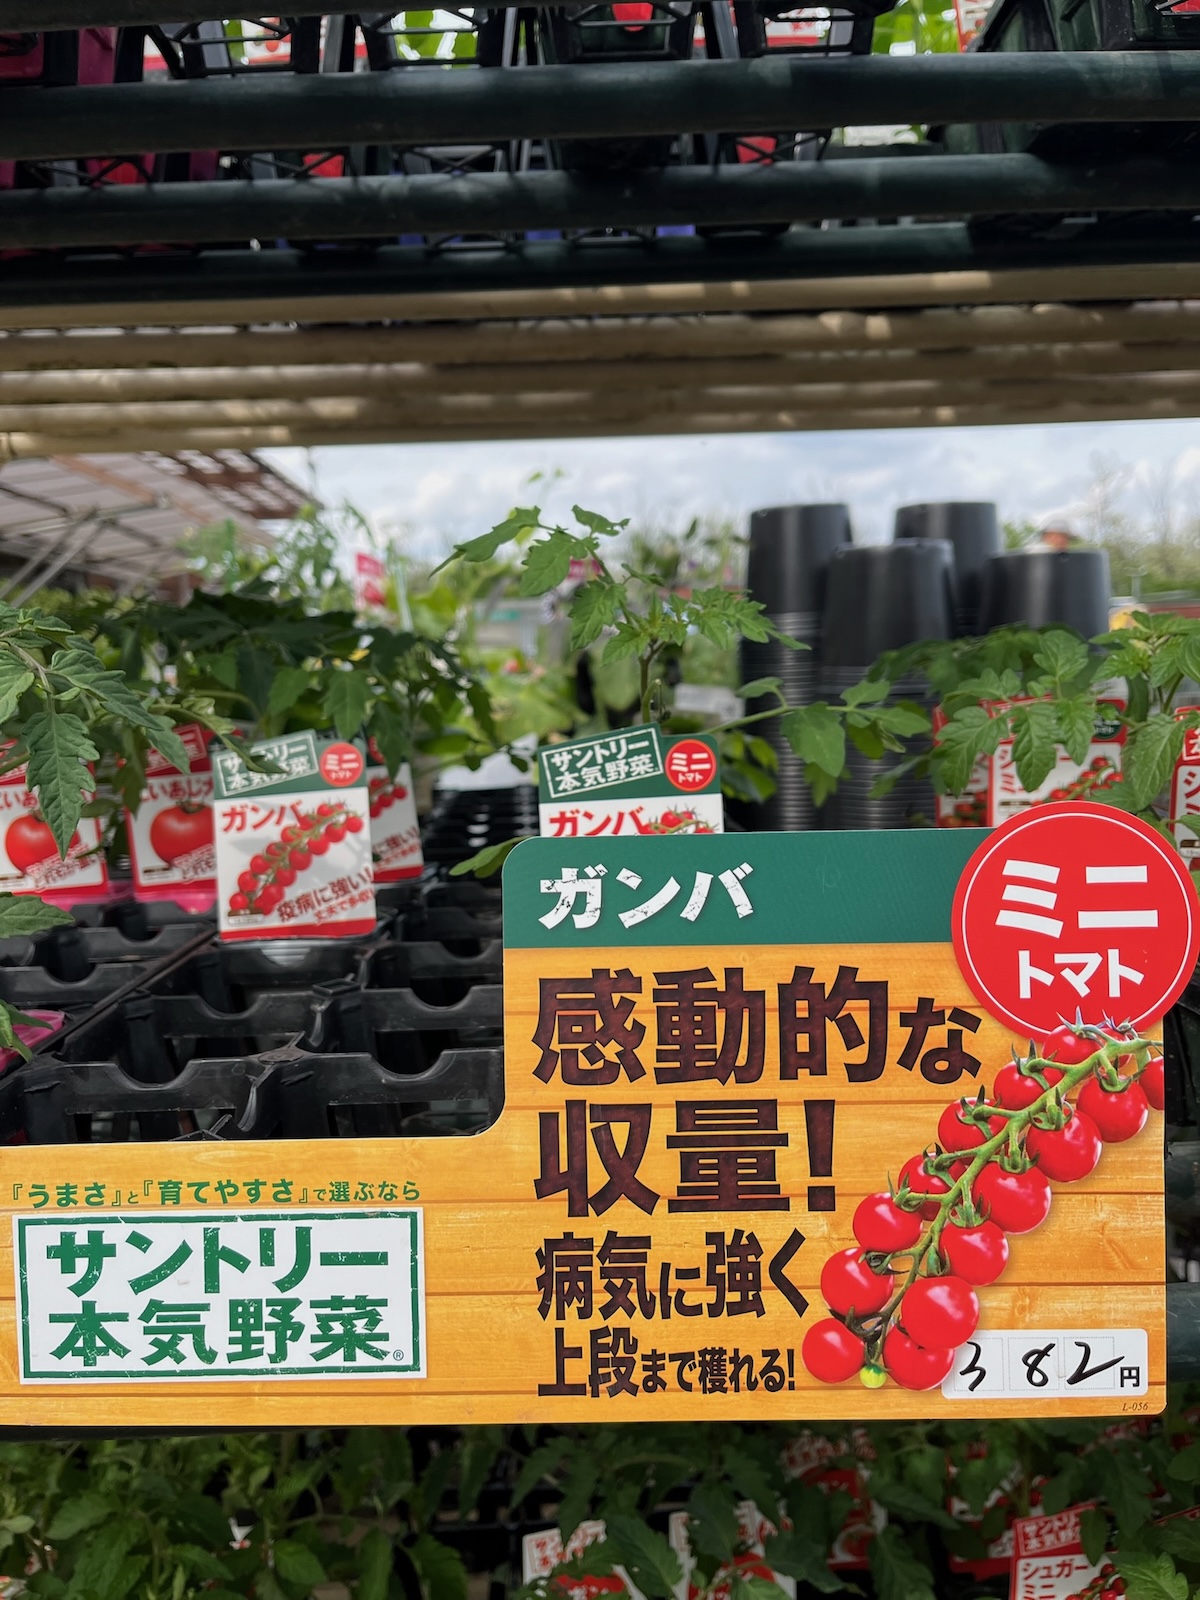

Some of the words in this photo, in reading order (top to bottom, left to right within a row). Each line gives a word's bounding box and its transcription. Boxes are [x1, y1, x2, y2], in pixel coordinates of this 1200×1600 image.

[222, 743, 308, 773] サリー
[325, 753, 359, 770] ミニ
[551, 738, 650, 772] サントリー
[555, 753, 655, 791] 本気野菜
[671, 752, 711, 772] ミニ
[678, 773, 703, 784] トマト
[222, 800, 303, 834] ガンバ
[549, 805, 644, 837] ガンバ
[538, 861, 755, 930] ガンバ
[995, 859, 1159, 939] ミニ
[1018, 947, 1145, 999] トマト
[531, 965, 983, 1087] 感動的な
[533, 1098, 836, 1218] 収量!
[11, 1178, 421, 1209] 『うまさ』と『育てやすさ』で選ぶなら
[45, 1226, 389, 1299] サントリー
[534, 1227, 810, 1321] 病気に強く
[537, 1325, 796, 1398] 上段まで獲れる!
[1122, 1402, 1149, 1412] L-056
[1023, 1558, 1089, 1581] シュガー
[1023, 1583, 1057, 1600] ミニ
